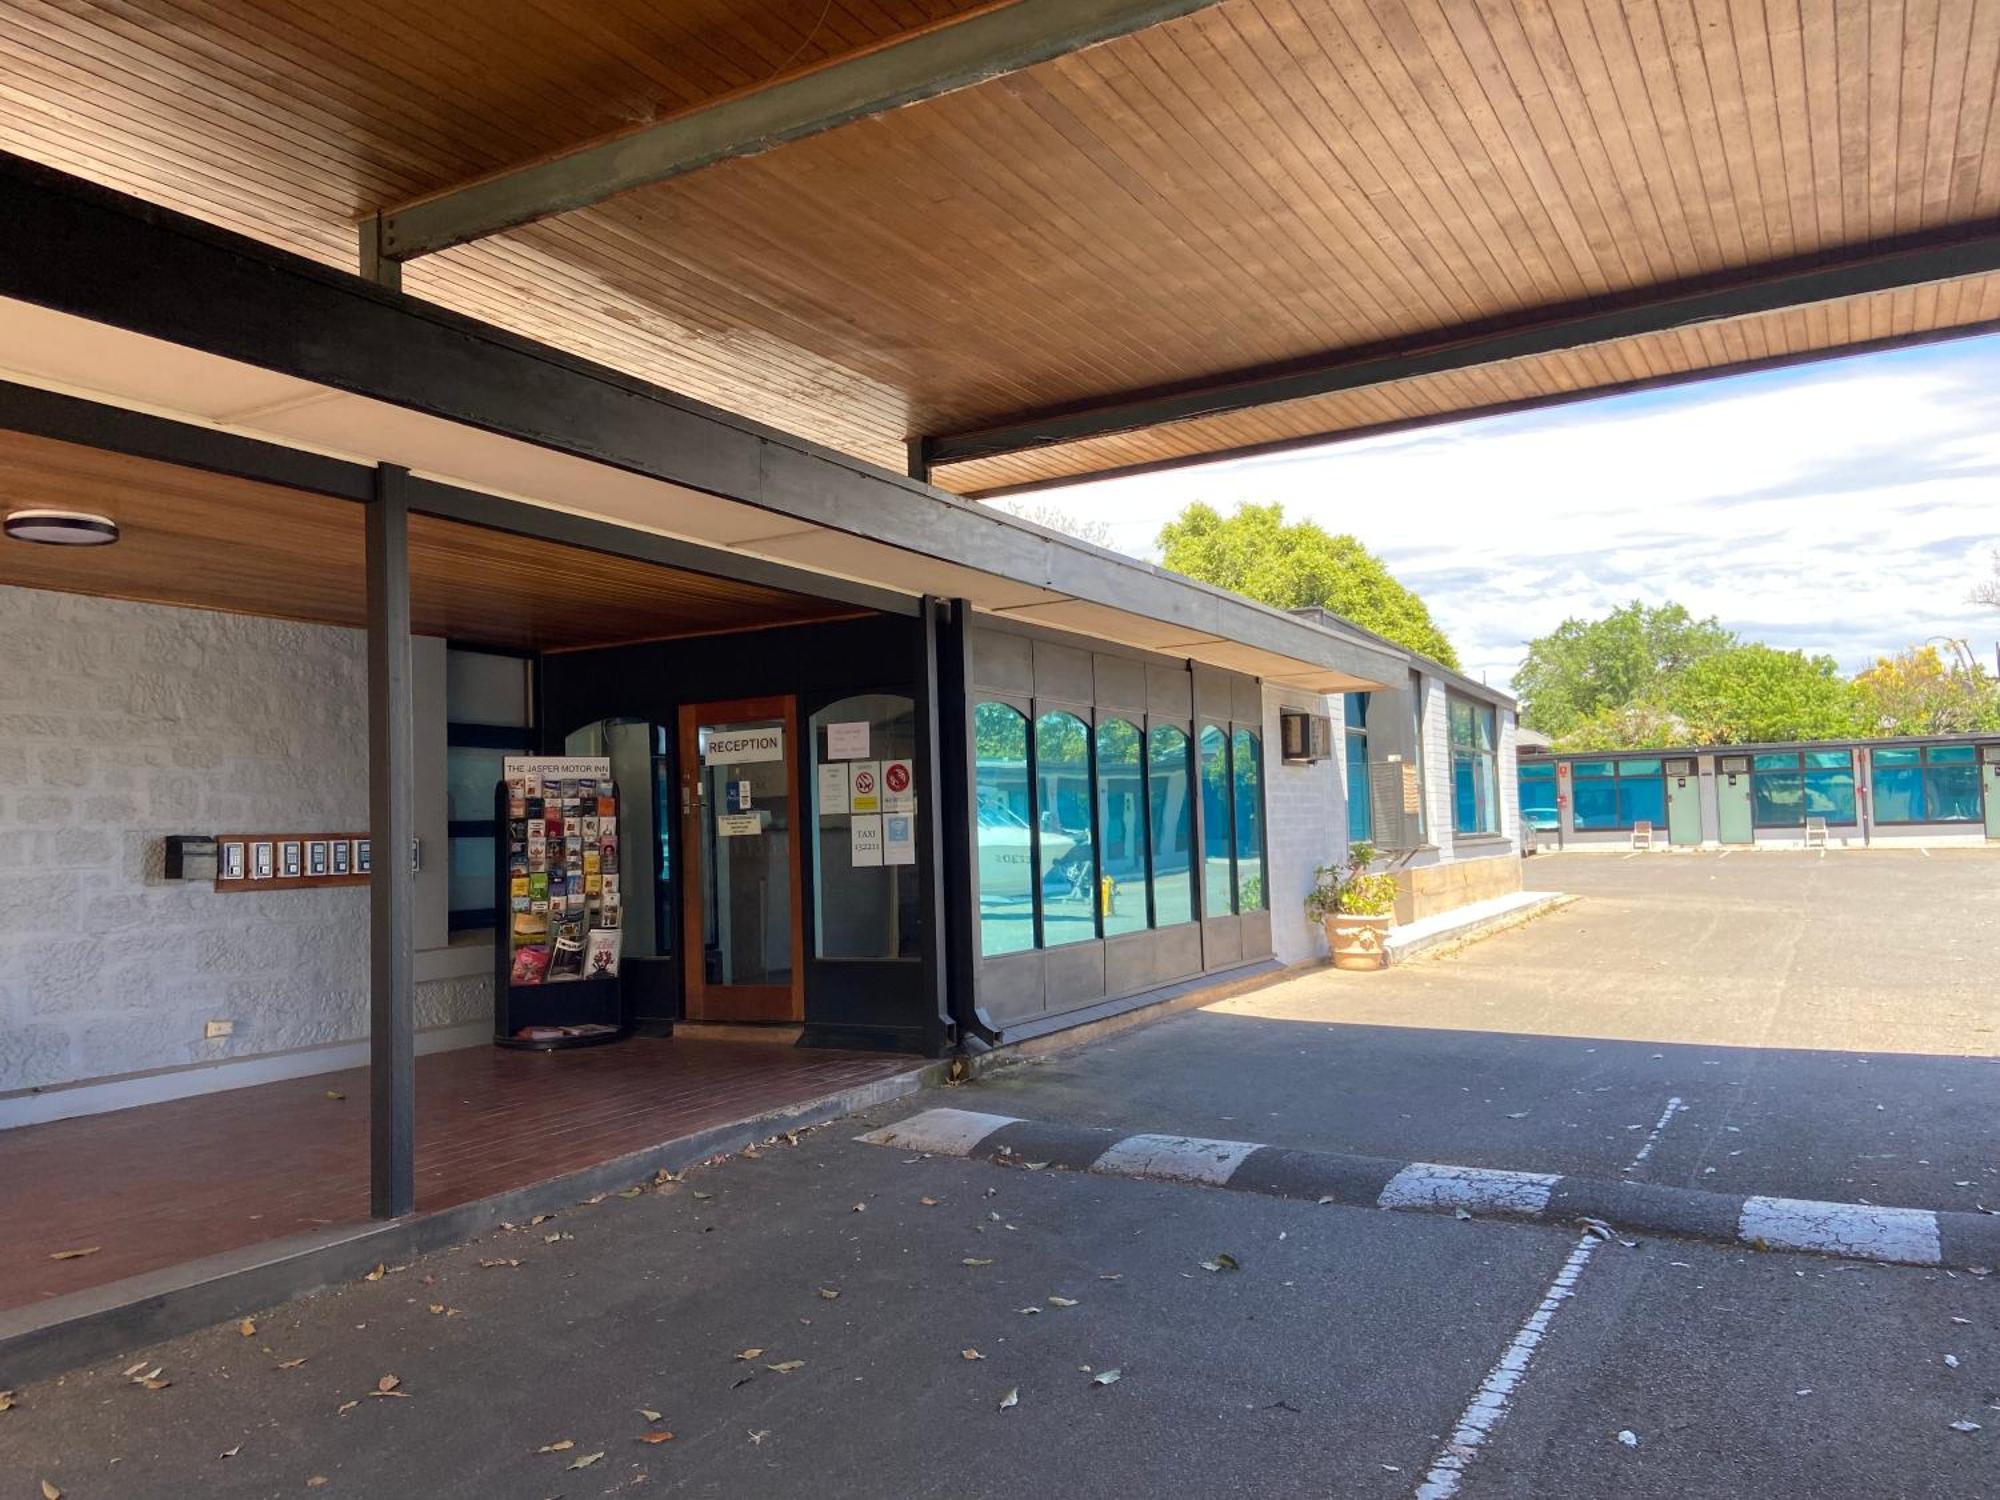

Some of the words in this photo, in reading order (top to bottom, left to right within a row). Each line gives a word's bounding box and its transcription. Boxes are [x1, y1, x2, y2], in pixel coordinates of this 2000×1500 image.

[708, 736, 778, 753] RECEPTION
[507, 764, 525, 773] THE
[527, 764, 560, 773] JASPER
[561, 764, 592, 773] MOTOR
[594, 764, 609, 773] INN
[857, 829, 876, 839] TAXI
